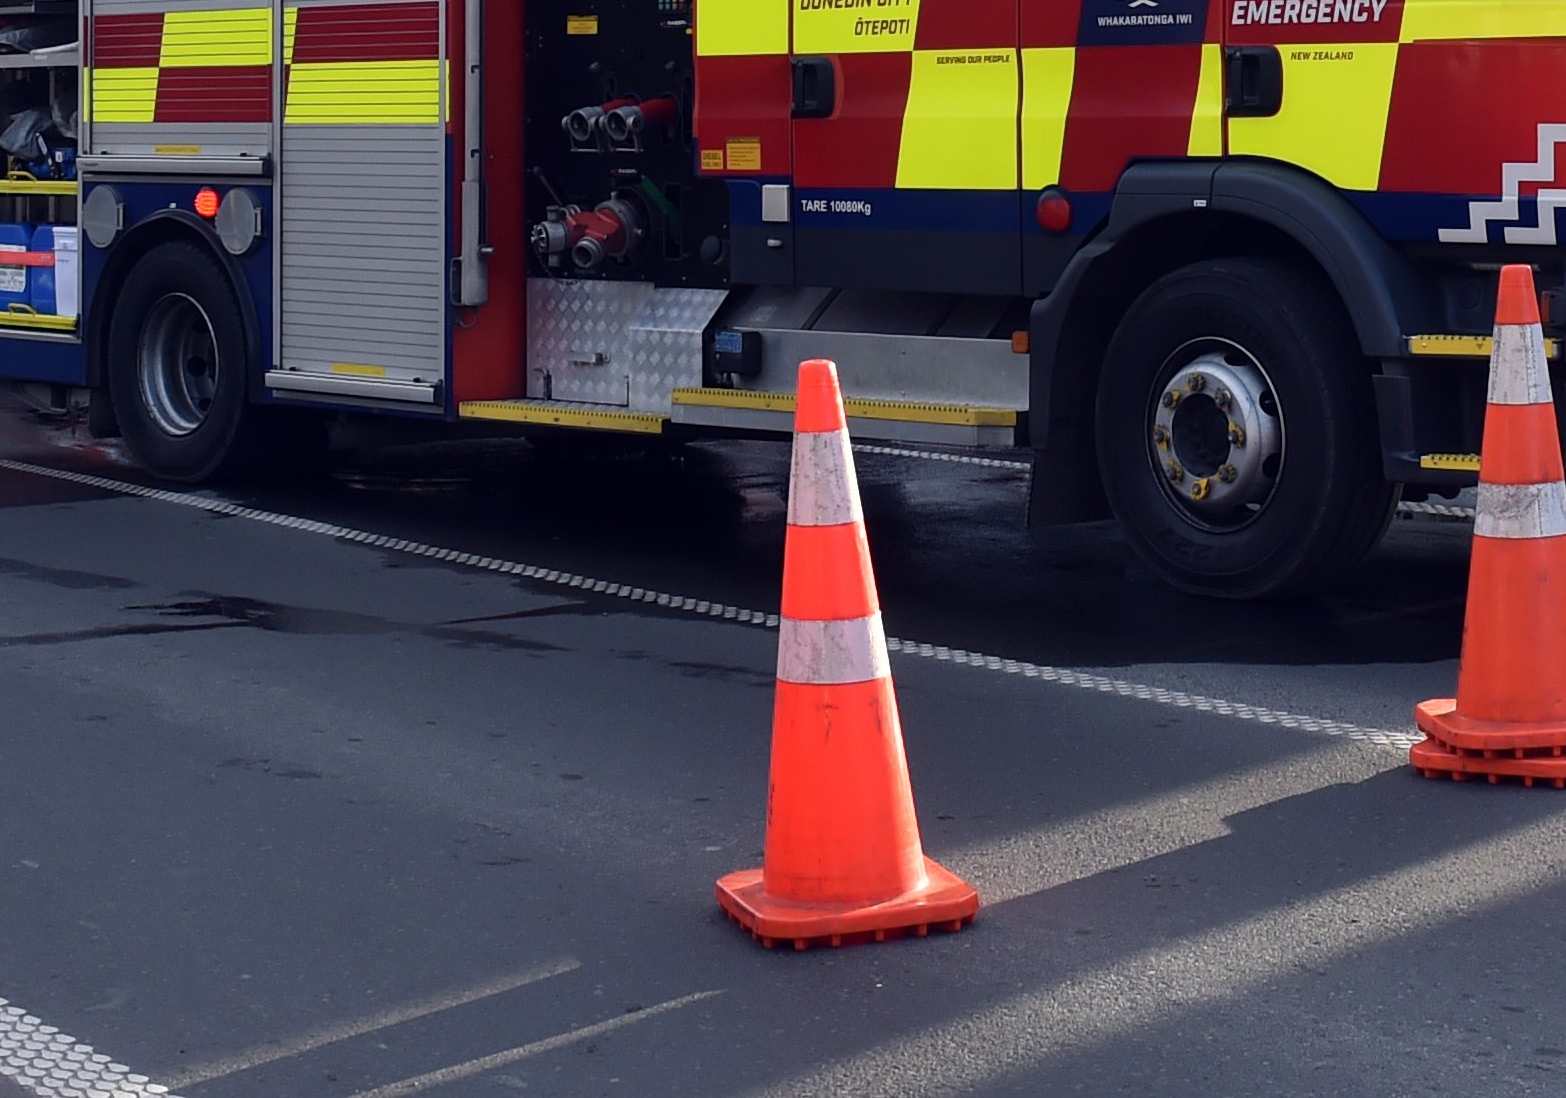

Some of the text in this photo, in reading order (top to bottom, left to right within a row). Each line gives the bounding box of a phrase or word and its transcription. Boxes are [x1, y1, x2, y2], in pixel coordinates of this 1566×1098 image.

[1097, 13, 1193, 27] WHAKARATONGA IWI
[936, 54, 1011, 65] SERVING OUR PEOPLE
[1290, 50, 1354, 61] NEW ZEALAND
[800, 199, 872, 216] TARE 10080Kg
